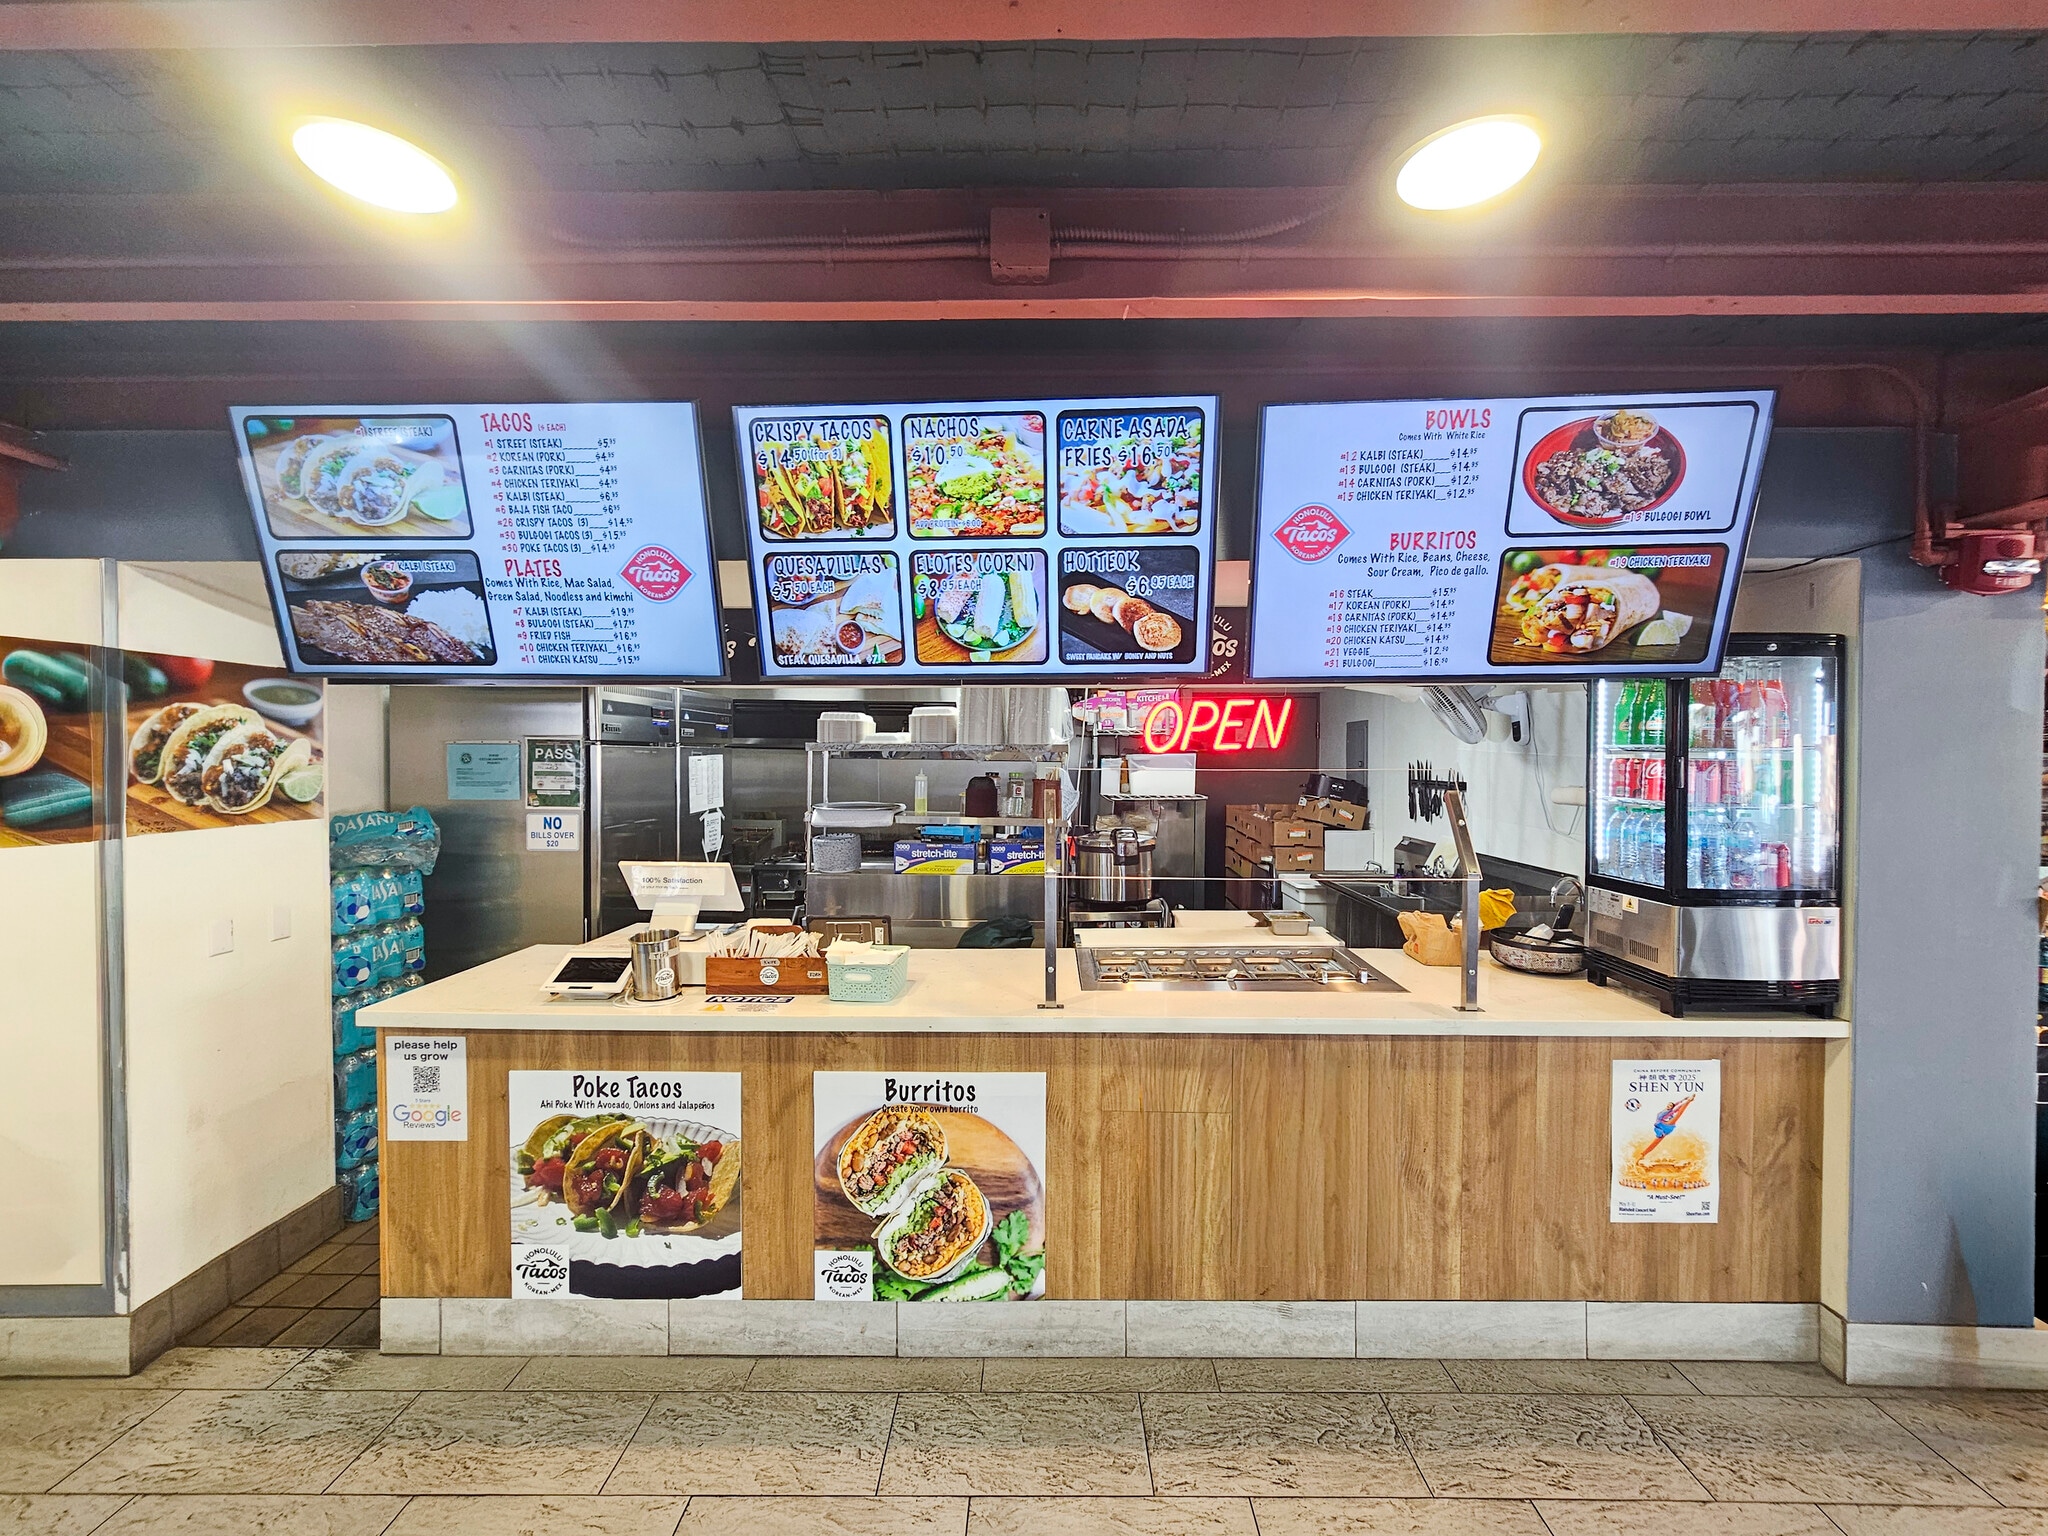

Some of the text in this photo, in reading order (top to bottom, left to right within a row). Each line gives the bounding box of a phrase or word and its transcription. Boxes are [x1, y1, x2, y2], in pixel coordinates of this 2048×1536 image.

[480, 412, 533, 432] TACOS
[1426, 408, 1491, 430] BOWLS
[755, 420, 872, 442] CRISPY TACOS
[911, 418, 980, 439] NACHOS
[1064, 418, 1188, 440] CARNE ASADA
[1398, 431, 1486, 441] Comes With White Rice
[497, 438, 526, 448] STREET
[500, 452, 534, 462] KOREAN
[810, 448, 829, 460] (for
[1065, 446, 1111, 466] FRIES
[1360, 450, 1386, 461] KALBI
[502, 465, 544, 476] CARNITAS
[1358, 464, 1396, 474] BULGOGI
[504, 478, 580, 489] CHICKEN TERIYAKI
[1358, 477, 1402, 488] CARNITAS
[506, 492, 530, 502] KALBI
[1356, 490, 1436, 501] CHICKEN TERIYAKI
[508, 504, 574, 514] BAJA FISH TACO
[1292, 508, 1334, 524] HONOLULU
[1644, 510, 1712, 522] BULGOGI BOWL
[516, 518, 574, 528] CRISPY TACOS
[518, 530, 580, 540] BULGOGI TACOS
[1282, 526, 1338, 544] Tacos
[1390, 530, 1477, 551] BURRITOS
[520, 543, 568, 553] POKE TACOS
[635, 549, 675, 564] HONOLULU
[1064, 551, 1140, 572] HOTTEOK
[1338, 550, 1491, 564] Comes With Rice, Beans, Cheese,
[1628, 555, 1710, 568] CHICKEN TERIYAKI
[397, 560, 422, 572] KALBI
[504, 558, 563, 578] PLATES
[774, 556, 881, 576] QUESADILLAS
[916, 554, 1035, 574] ELOTES (CORN)
[628, 566, 680, 583] Tacos
[1367, 564, 1489, 578] Sour Cream, Pico de gallo.
[485, 577, 615, 590] Comes With Rice, Mac Salad,
[958, 580, 982, 590] EACH
[1168, 574, 1194, 588] EACH
[1995, 577, 2022, 586] FIRE
[810, 582, 834, 592] EACH
[487, 591, 634, 602] Green Salad, Noodless and kimchi
[1346, 600, 1380, 610] KOREAN
[525, 607, 549, 616] KALBI
[1344, 612, 1386, 622] CARNITAS
[528, 619, 560, 628] BULGOGI
[1344, 624, 1417, 634] CHICKEN TERIYAKI
[530, 631, 571, 640] FRIED FISH
[1344, 635, 1406, 645] CHICKEN KATSU
[536, 643, 608, 652] CHICKEN TERIYAKI
[538, 654, 598, 664] CHICKEN KATSU
[778, 654, 862, 665] STEAK QUESADILLA
[1145, 698, 1293, 754] OPEN
[535, 748, 574, 760] PASS
[334, 812, 394, 836] DASANI
[543, 816, 562, 830] NO
[912, 848, 958, 858] stretch-tite
[662, 876, 703, 884] Satisfaction
[394, 1040, 458, 1051] please help
[420, 1053, 448, 1062] grow
[572, 1074, 682, 1099] Poke Tacos
[884, 1078, 976, 1102] Burritos
[1628, 1082, 1705, 1092] SHEN YUN
[540, 1100, 716, 1111] Ahi Poke With Avocado, Onions and Jalapeños
[882, 1104, 979, 1114] Create your own burrito
[392, 1104, 462, 1126] Google
[524, 1248, 564, 1262] HONOLULU
[828, 1254, 864, 1268] HONOLULU
[516, 1264, 568, 1280] Tacos
[821, 1269, 868, 1284] Tacos
